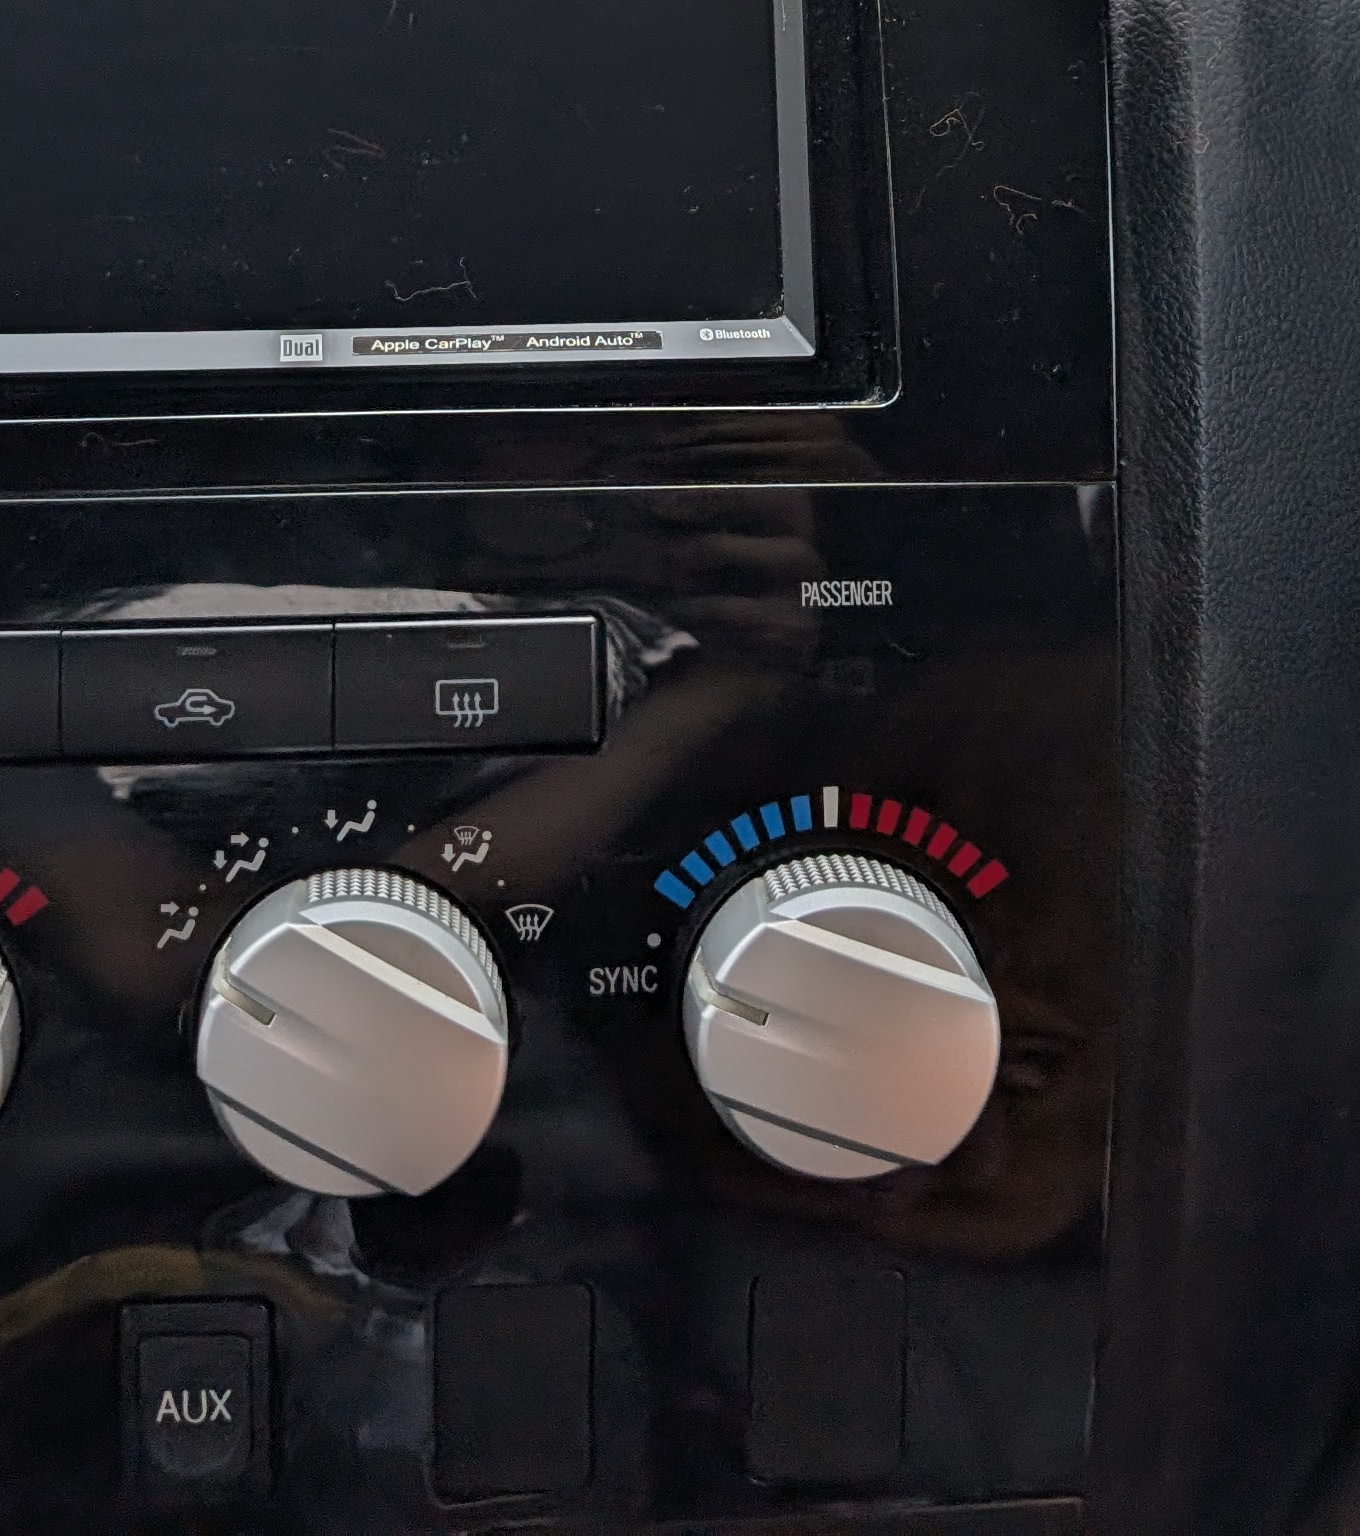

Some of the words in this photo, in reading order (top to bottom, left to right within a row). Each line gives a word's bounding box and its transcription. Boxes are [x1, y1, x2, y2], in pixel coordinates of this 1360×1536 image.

[526, 335, 591, 348] Android
[715, 329, 771, 339] Bluetooth
[283, 338, 320, 357] Dual
[371, 338, 420, 352] Apple
[801, 580, 894, 607] PASSENGER
[589, 965, 659, 995] SYNC
[156, 1389, 232, 1424] AUX
